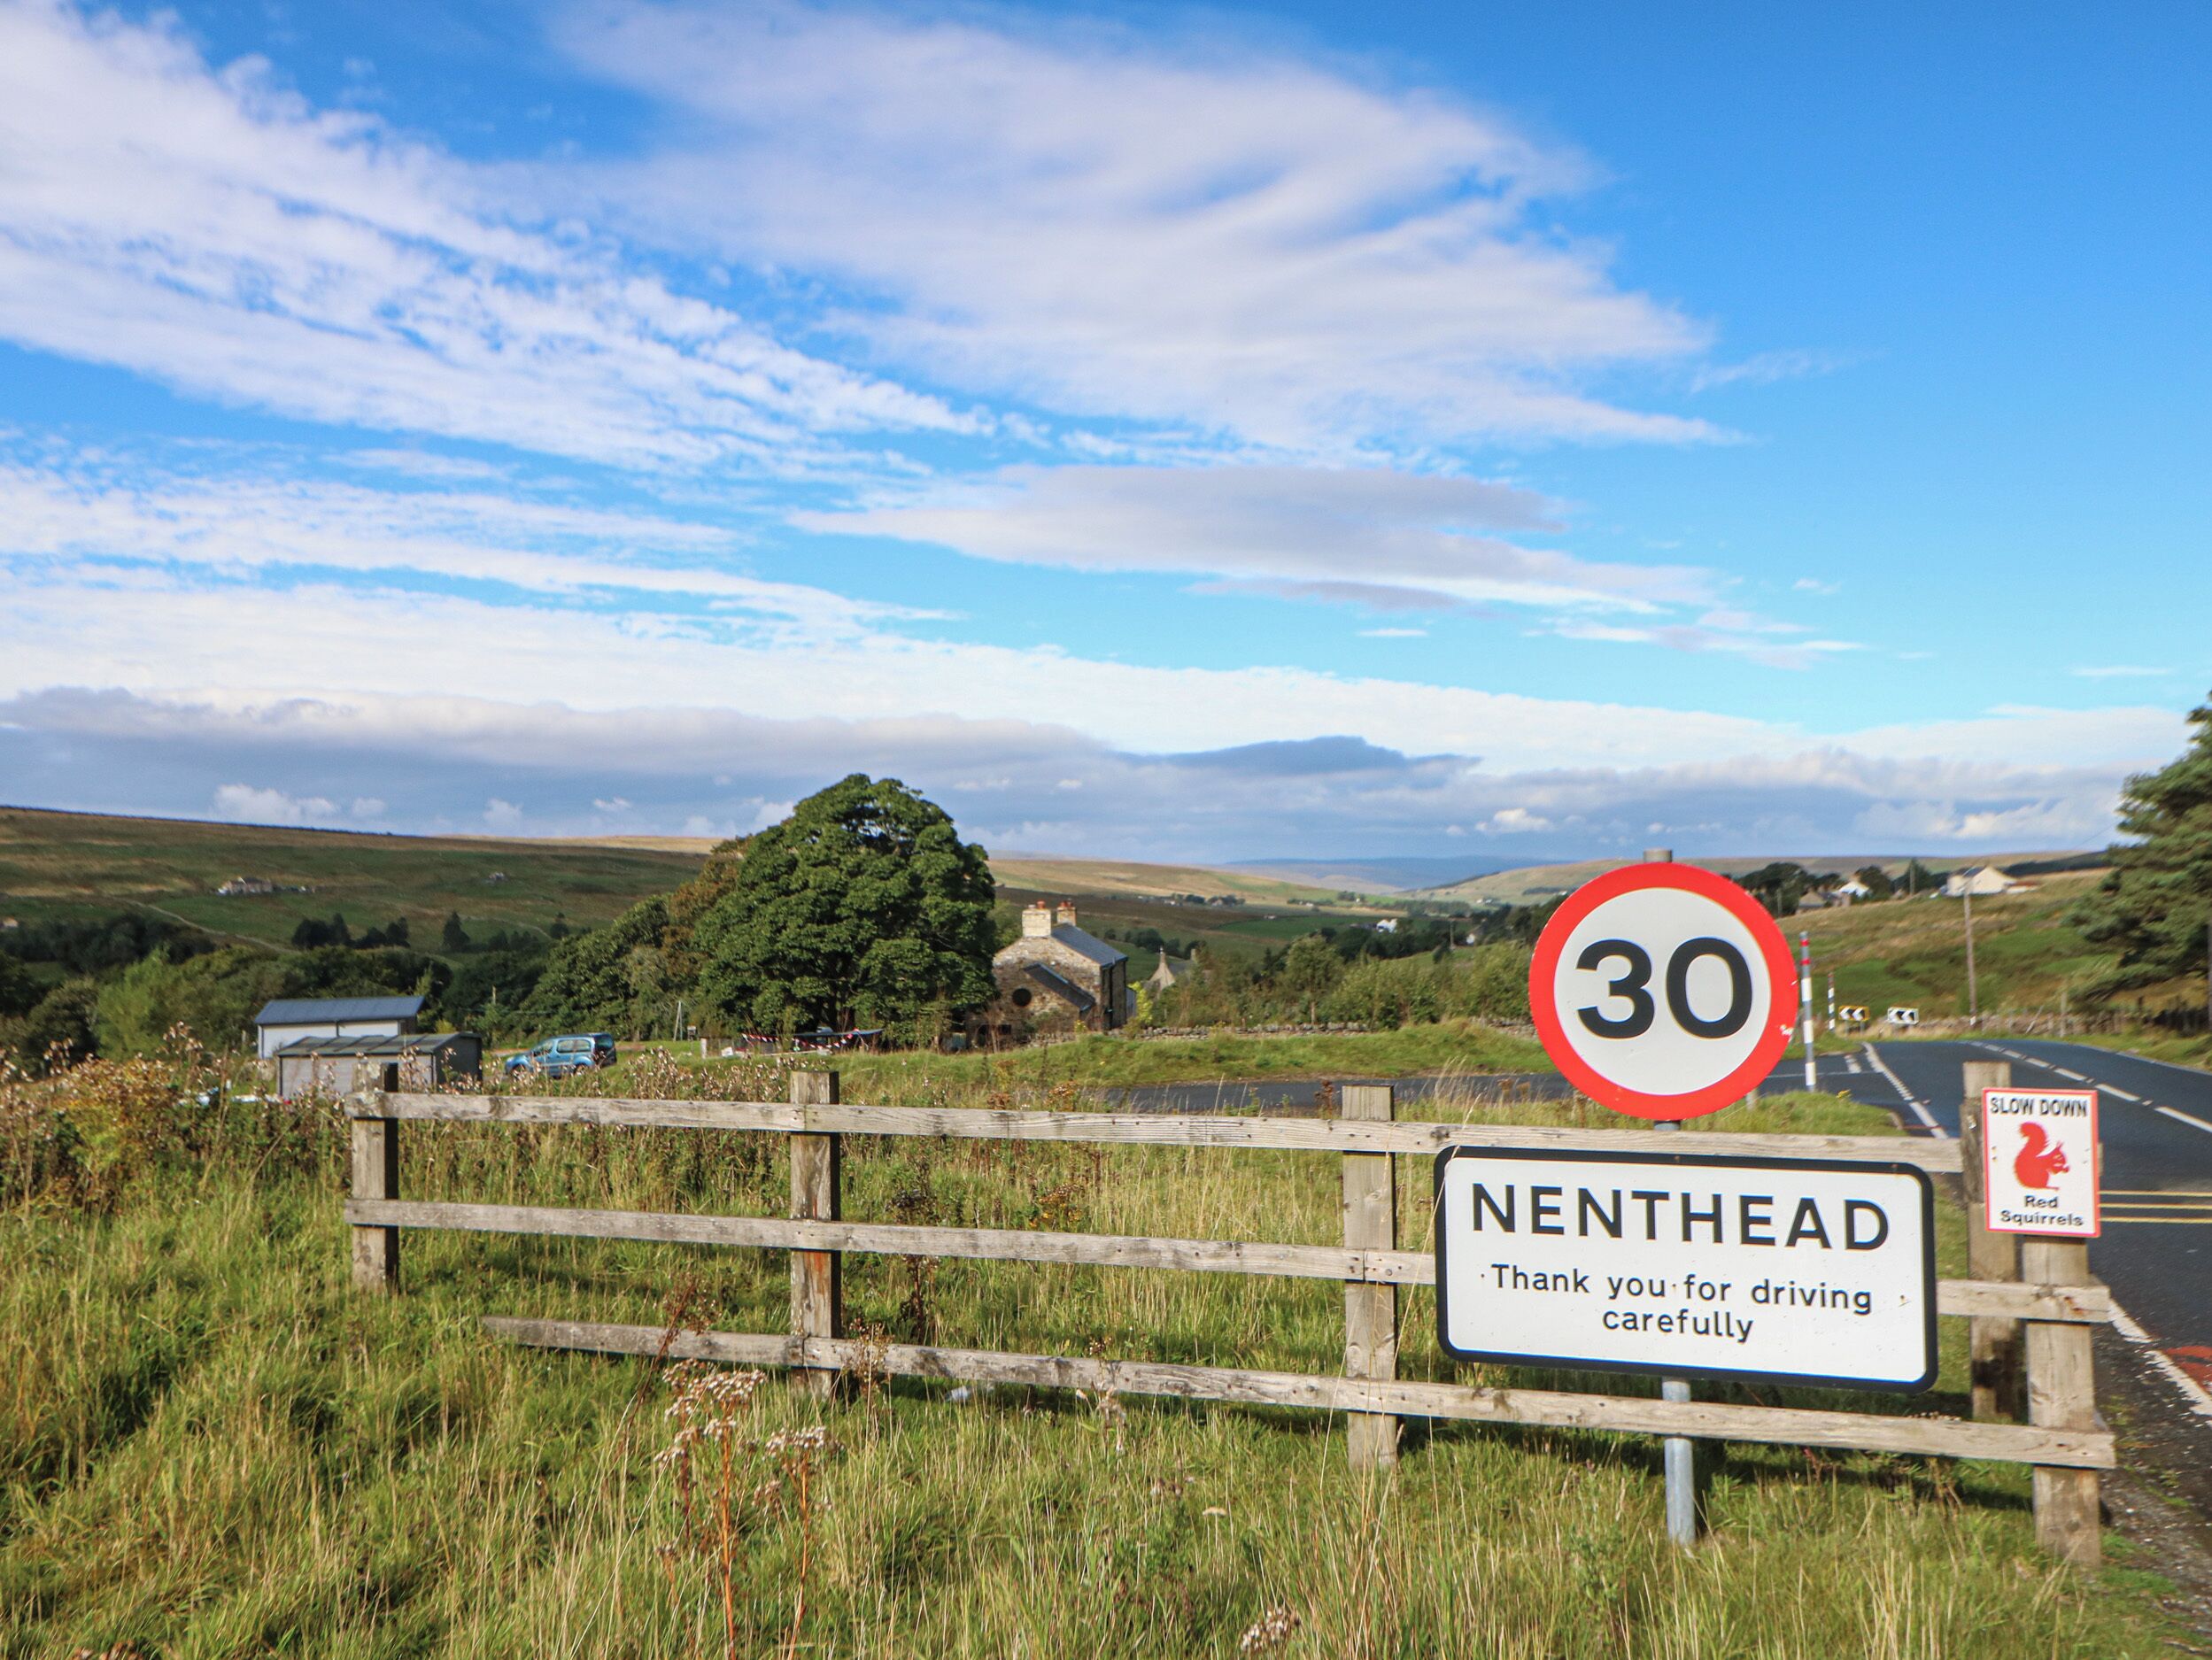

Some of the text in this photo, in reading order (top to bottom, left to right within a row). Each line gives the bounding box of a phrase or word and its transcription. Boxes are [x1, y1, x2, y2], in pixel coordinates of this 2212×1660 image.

[1576, 937, 1753, 1039] 30
[1990, 1097, 2088, 1117] SLOW DOWN
[1473, 1183, 1889, 1251] NENTHEAD
[2000, 1209, 2084, 1226] Squirrels
[2024, 1195, 2059, 1208] Red
[1491, 1263, 1872, 1316] Thank you for driving
[1603, 1309, 1754, 1344] carefully
